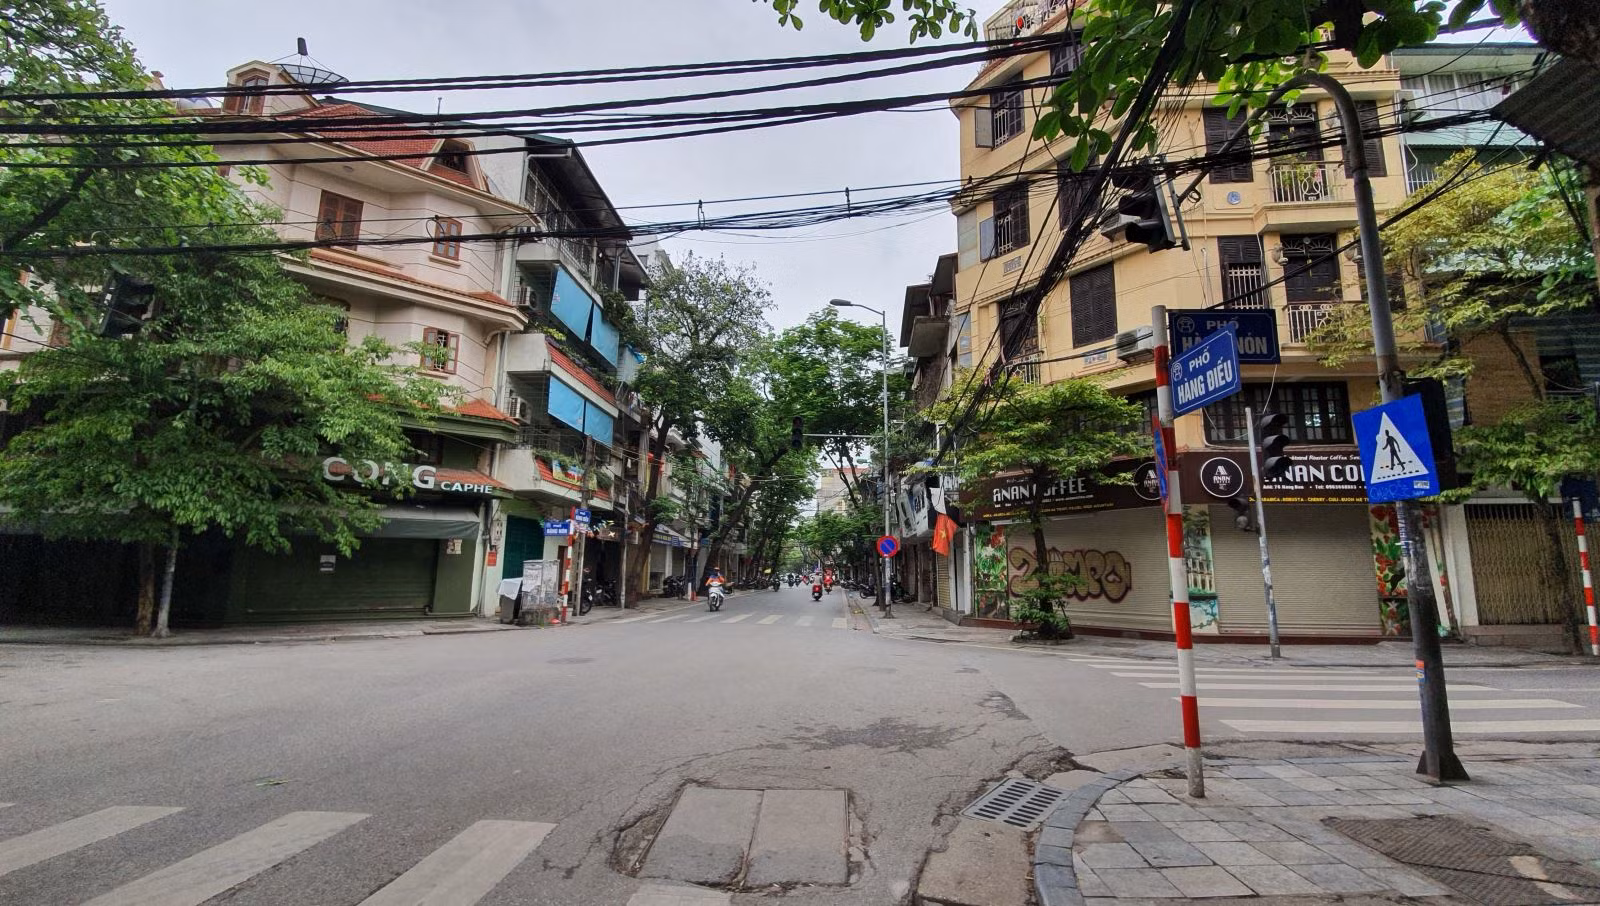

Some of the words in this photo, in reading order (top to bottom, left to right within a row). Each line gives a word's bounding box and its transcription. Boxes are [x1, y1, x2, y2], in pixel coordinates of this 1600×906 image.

[1237, 332, 1268, 354] NÓN
[1189, 346, 1211, 372] PHỐ
[1177, 374, 1206, 405] HÀNG
[1206, 356, 1233, 392] ĐIẾU
[440, 481, 493, 494] CAPHE
[993, 484, 1030, 502] ANAN
